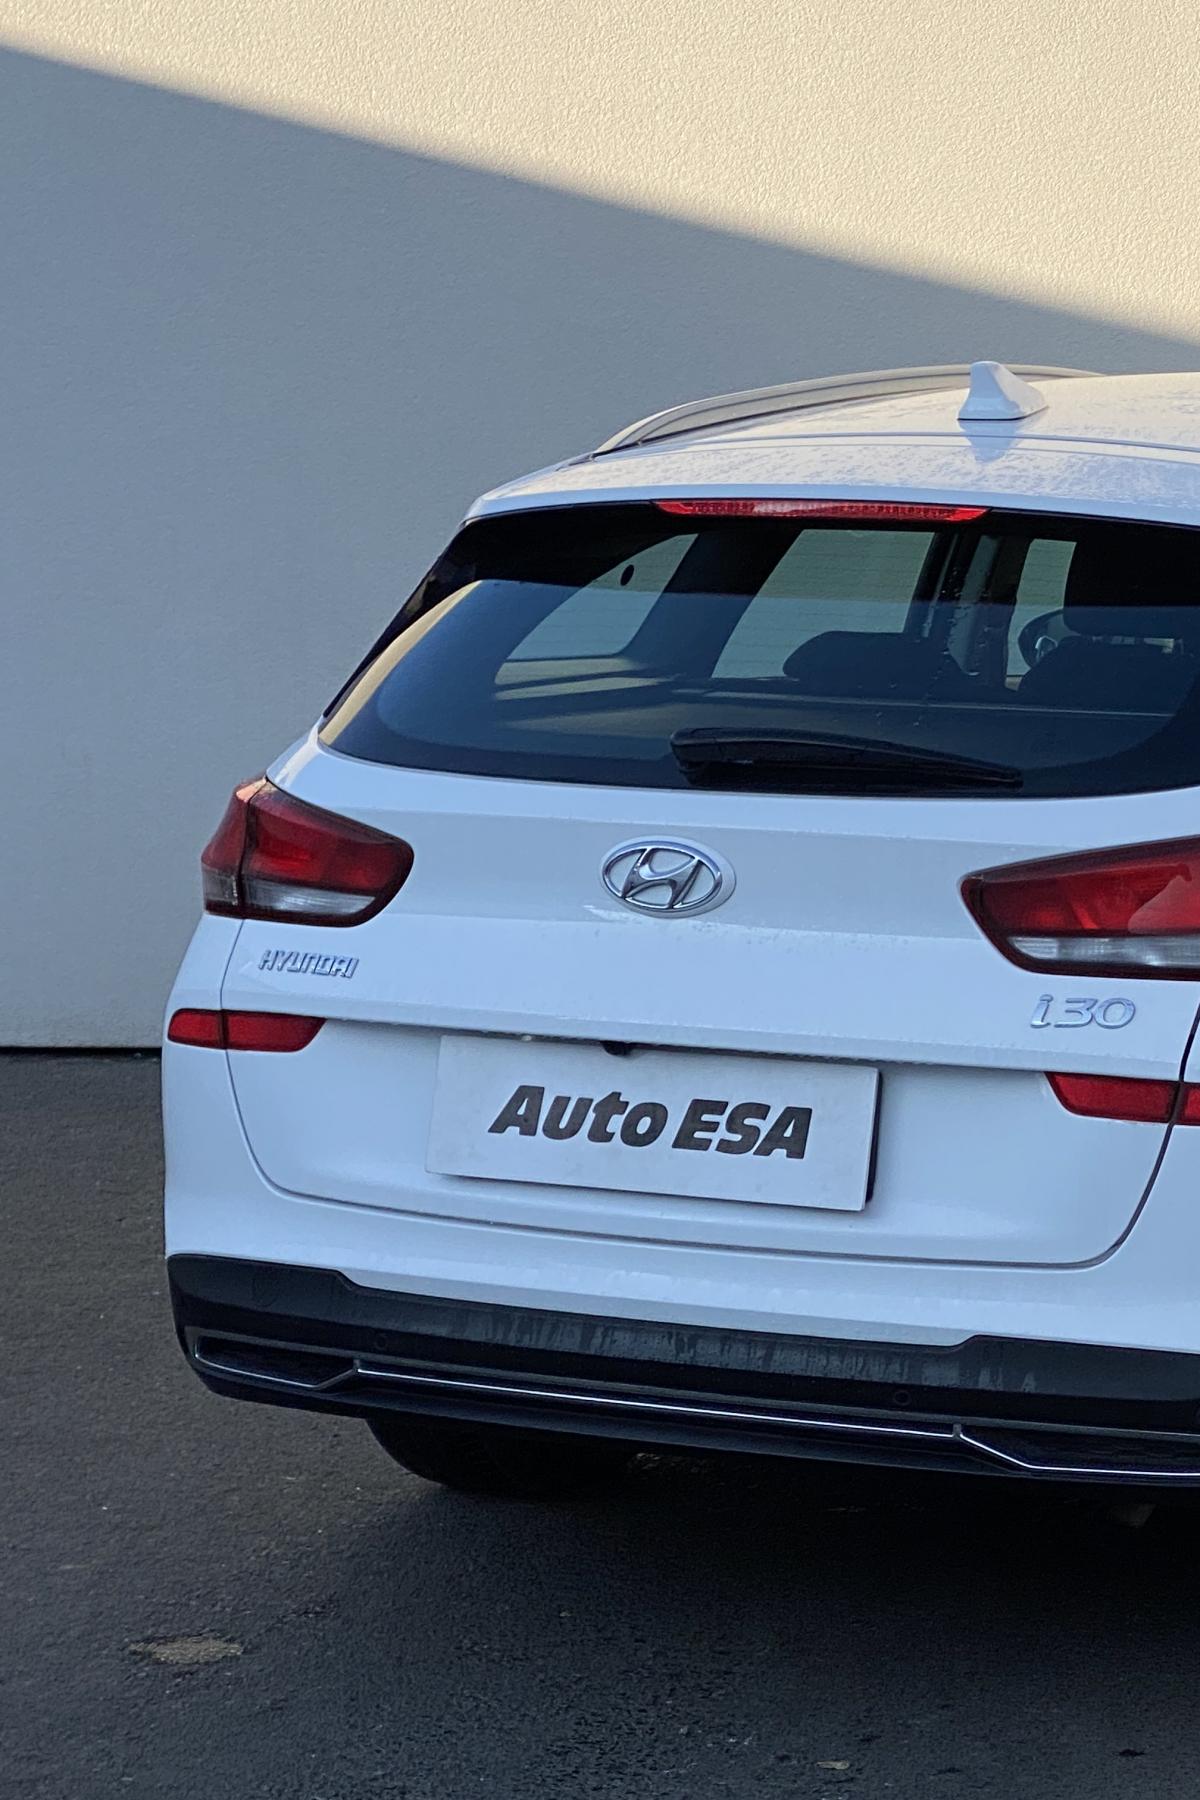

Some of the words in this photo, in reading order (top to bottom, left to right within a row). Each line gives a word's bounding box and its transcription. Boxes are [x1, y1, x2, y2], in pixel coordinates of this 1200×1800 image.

[258, 949, 360, 979] HYUNDAI
[1030, 994, 1136, 1029] i30
[487, 1085, 669, 1147] Auto
[671, 1098, 813, 1159] ESA
